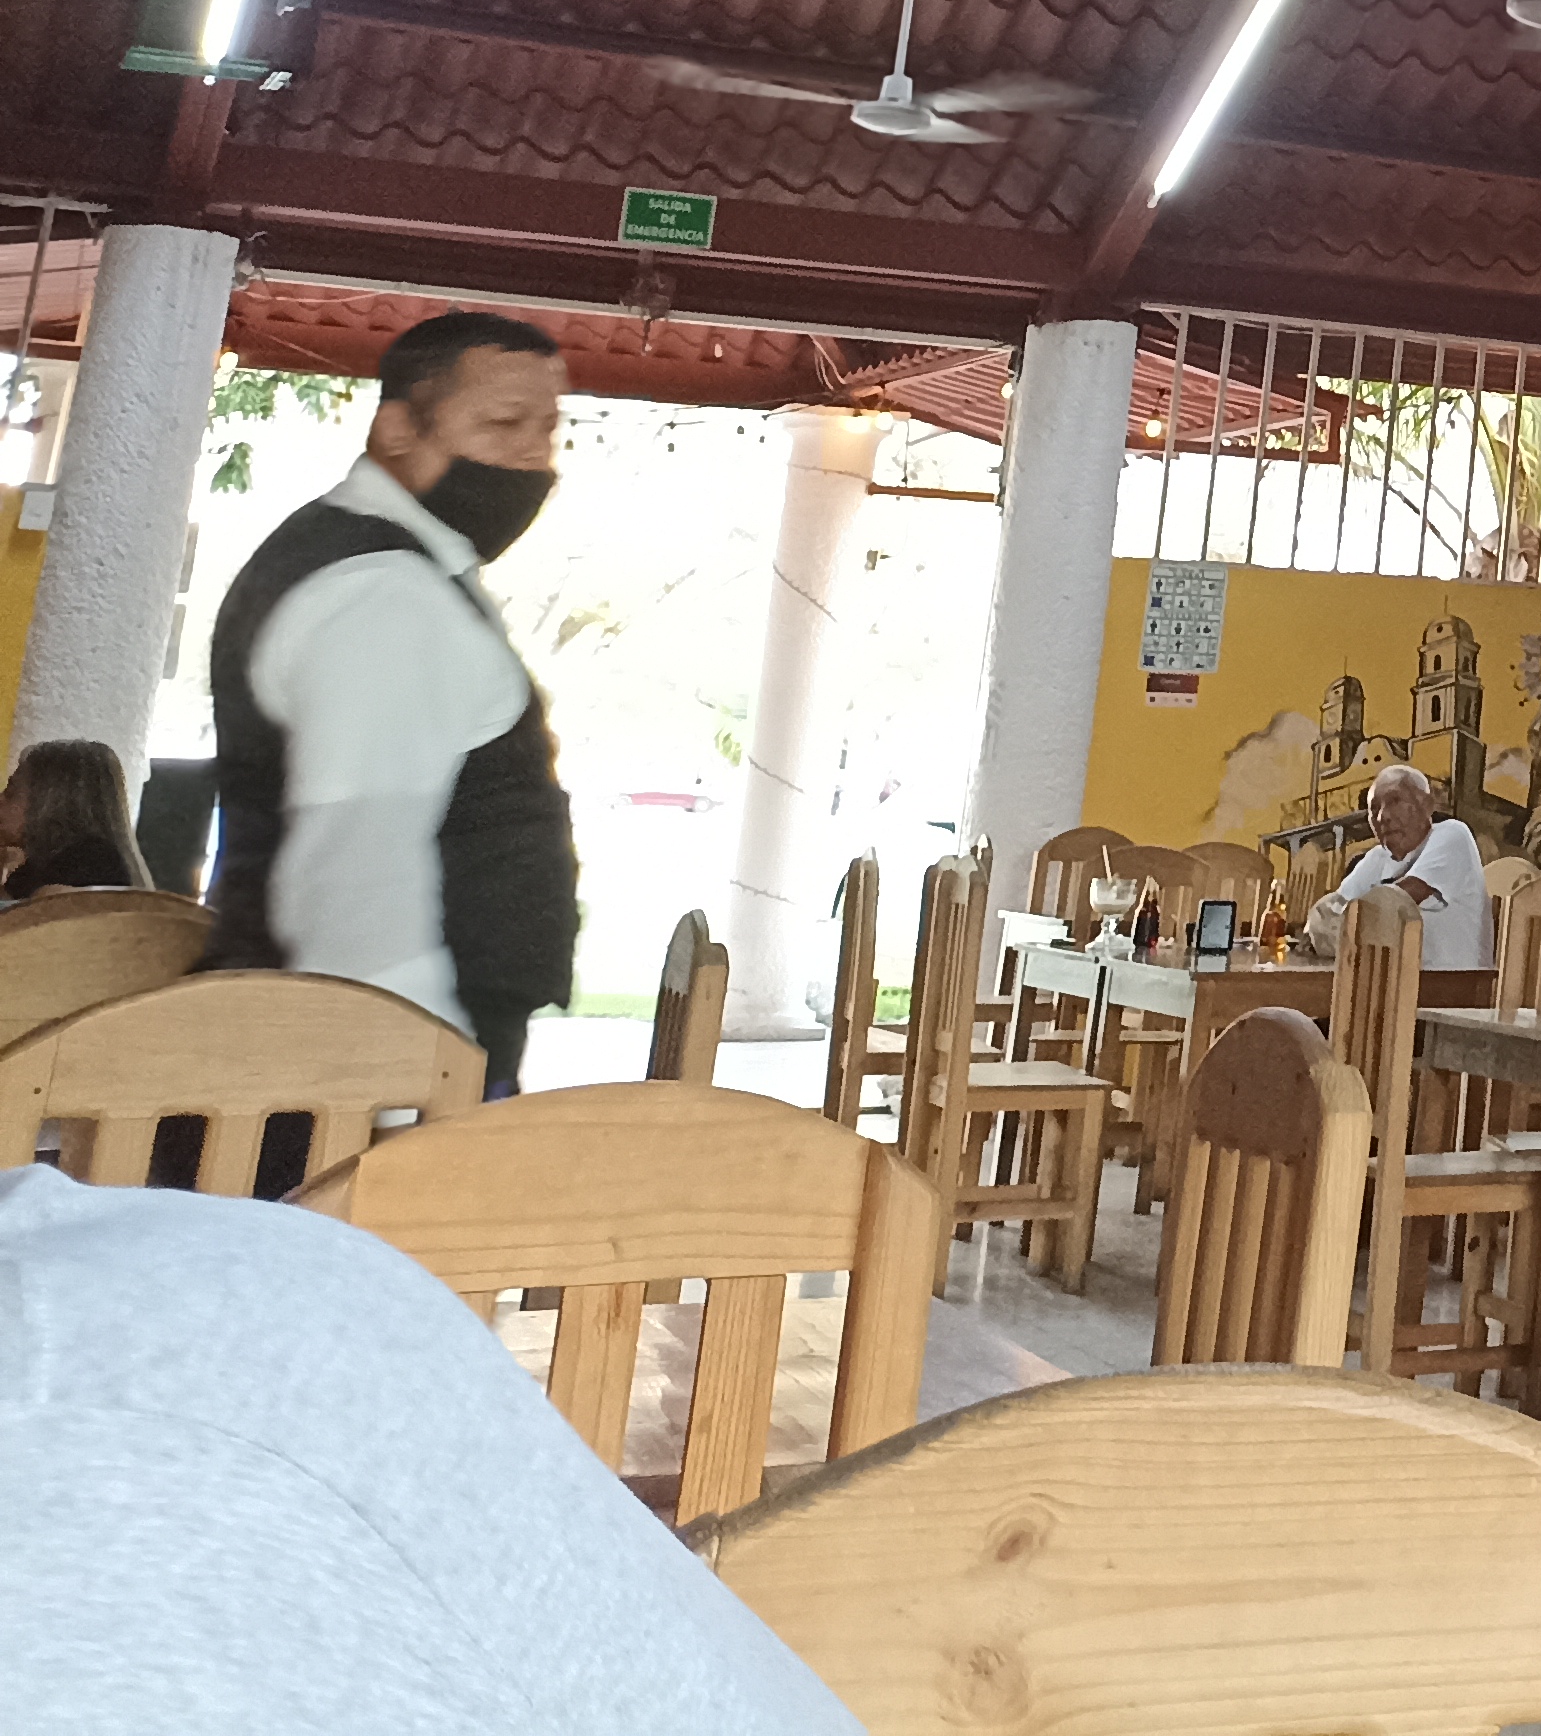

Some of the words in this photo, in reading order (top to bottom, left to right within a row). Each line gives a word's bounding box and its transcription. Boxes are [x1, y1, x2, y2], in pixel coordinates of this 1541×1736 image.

[648, 197, 692, 213] SALIDA
[659, 213, 677, 225] DE
[626, 224, 704, 241] EMERGENCIA
